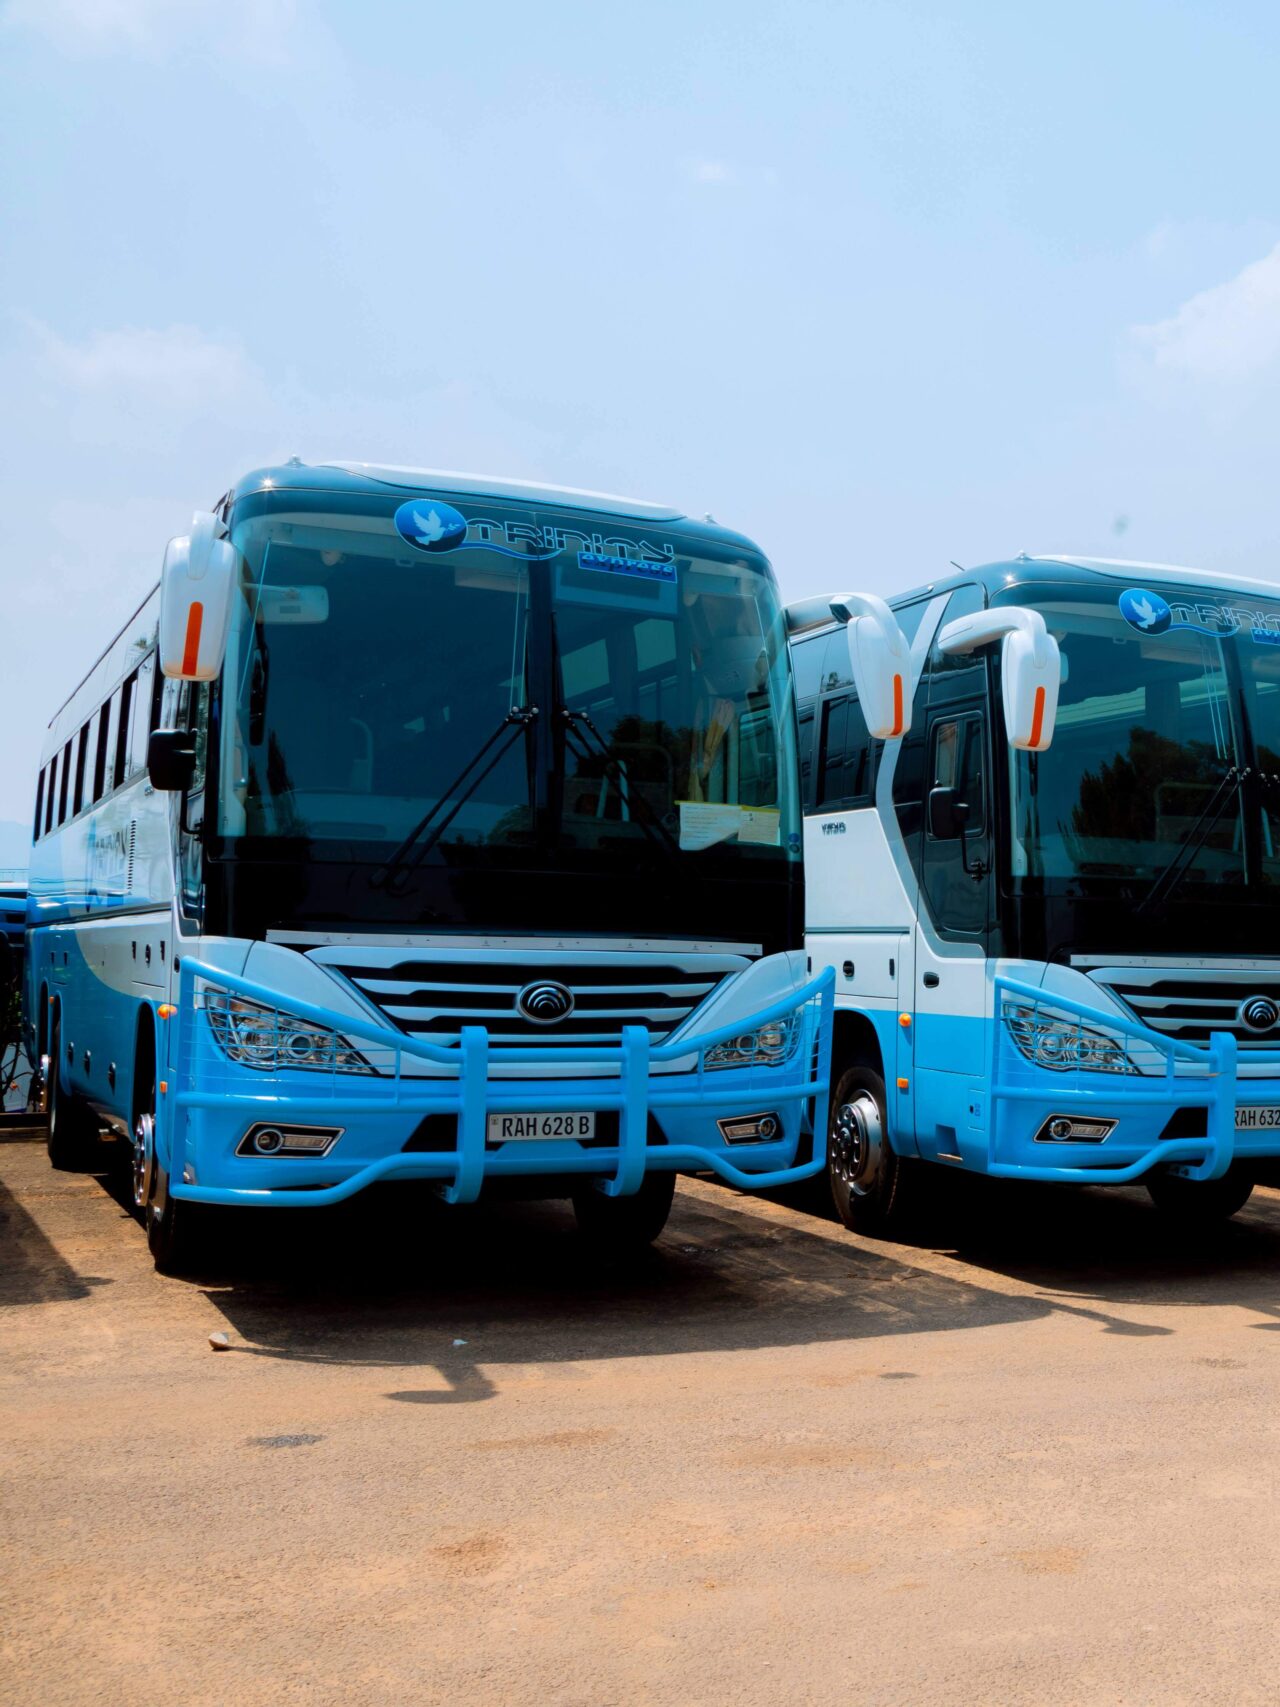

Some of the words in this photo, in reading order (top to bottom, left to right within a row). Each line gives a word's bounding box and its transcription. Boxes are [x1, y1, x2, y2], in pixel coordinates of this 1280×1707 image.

[466, 518, 675, 564] TRINITY
[581, 554, 674, 577] express
[502, 1117, 537, 1137] RAH
[541, 1116, 574, 1136] 628
[579, 1115, 590, 1135] B
[1259, 1109, 1280, 1126] 632
